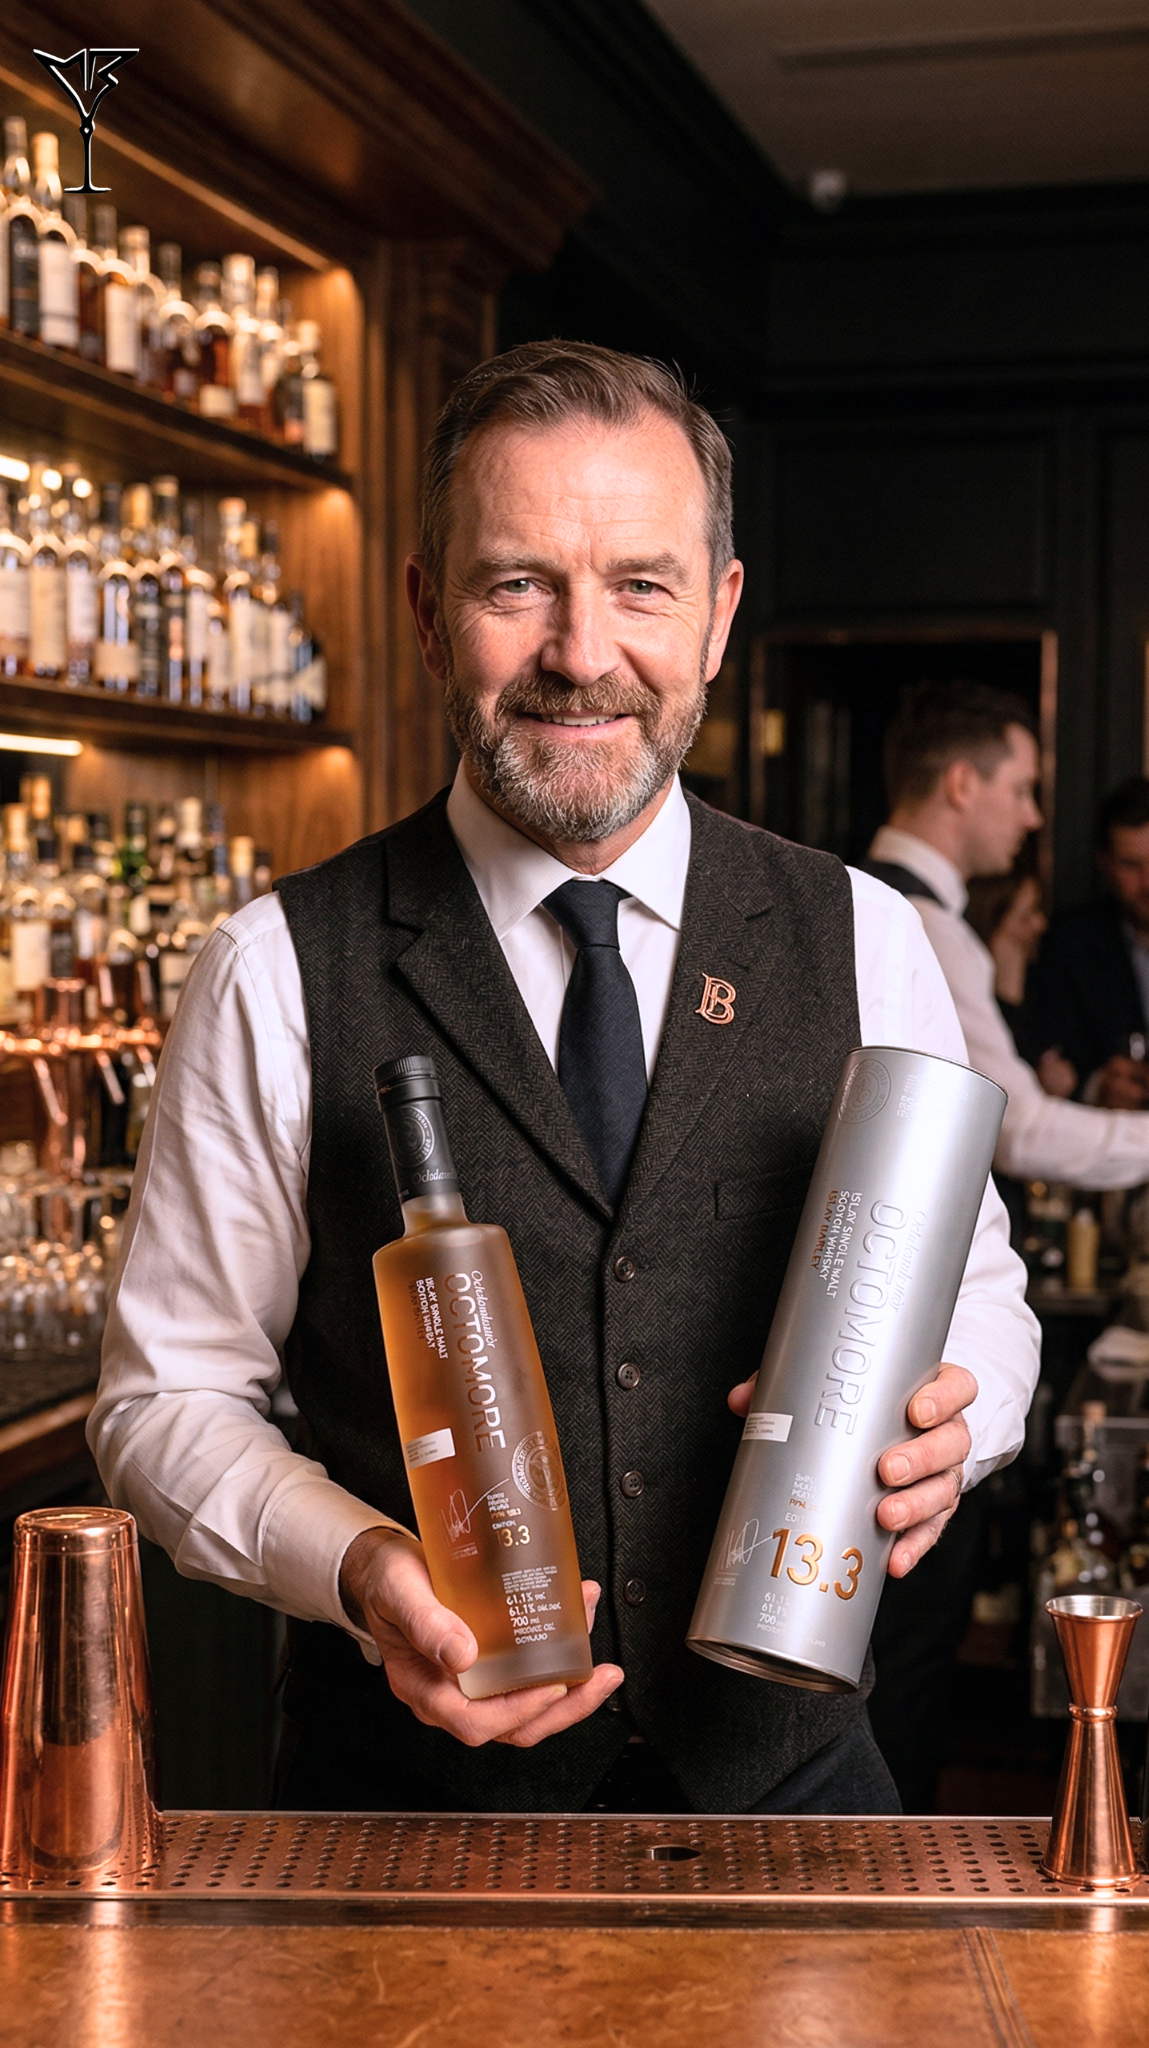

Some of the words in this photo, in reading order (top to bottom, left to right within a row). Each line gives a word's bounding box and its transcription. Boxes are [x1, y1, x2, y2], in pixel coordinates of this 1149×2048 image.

[846, 1192, 863, 1224] ISLAY
[826, 1267, 842, 1299] MALT
[814, 1199, 909, 1435] OCTOMORE
[444, 1272, 507, 1452] OCTOMORE
[495, 1525, 531, 1547] 13.3
[769, 1527, 864, 1600] 13.3
[511, 1616, 528, 1627] 700
[759, 1612, 776, 1625] 700
